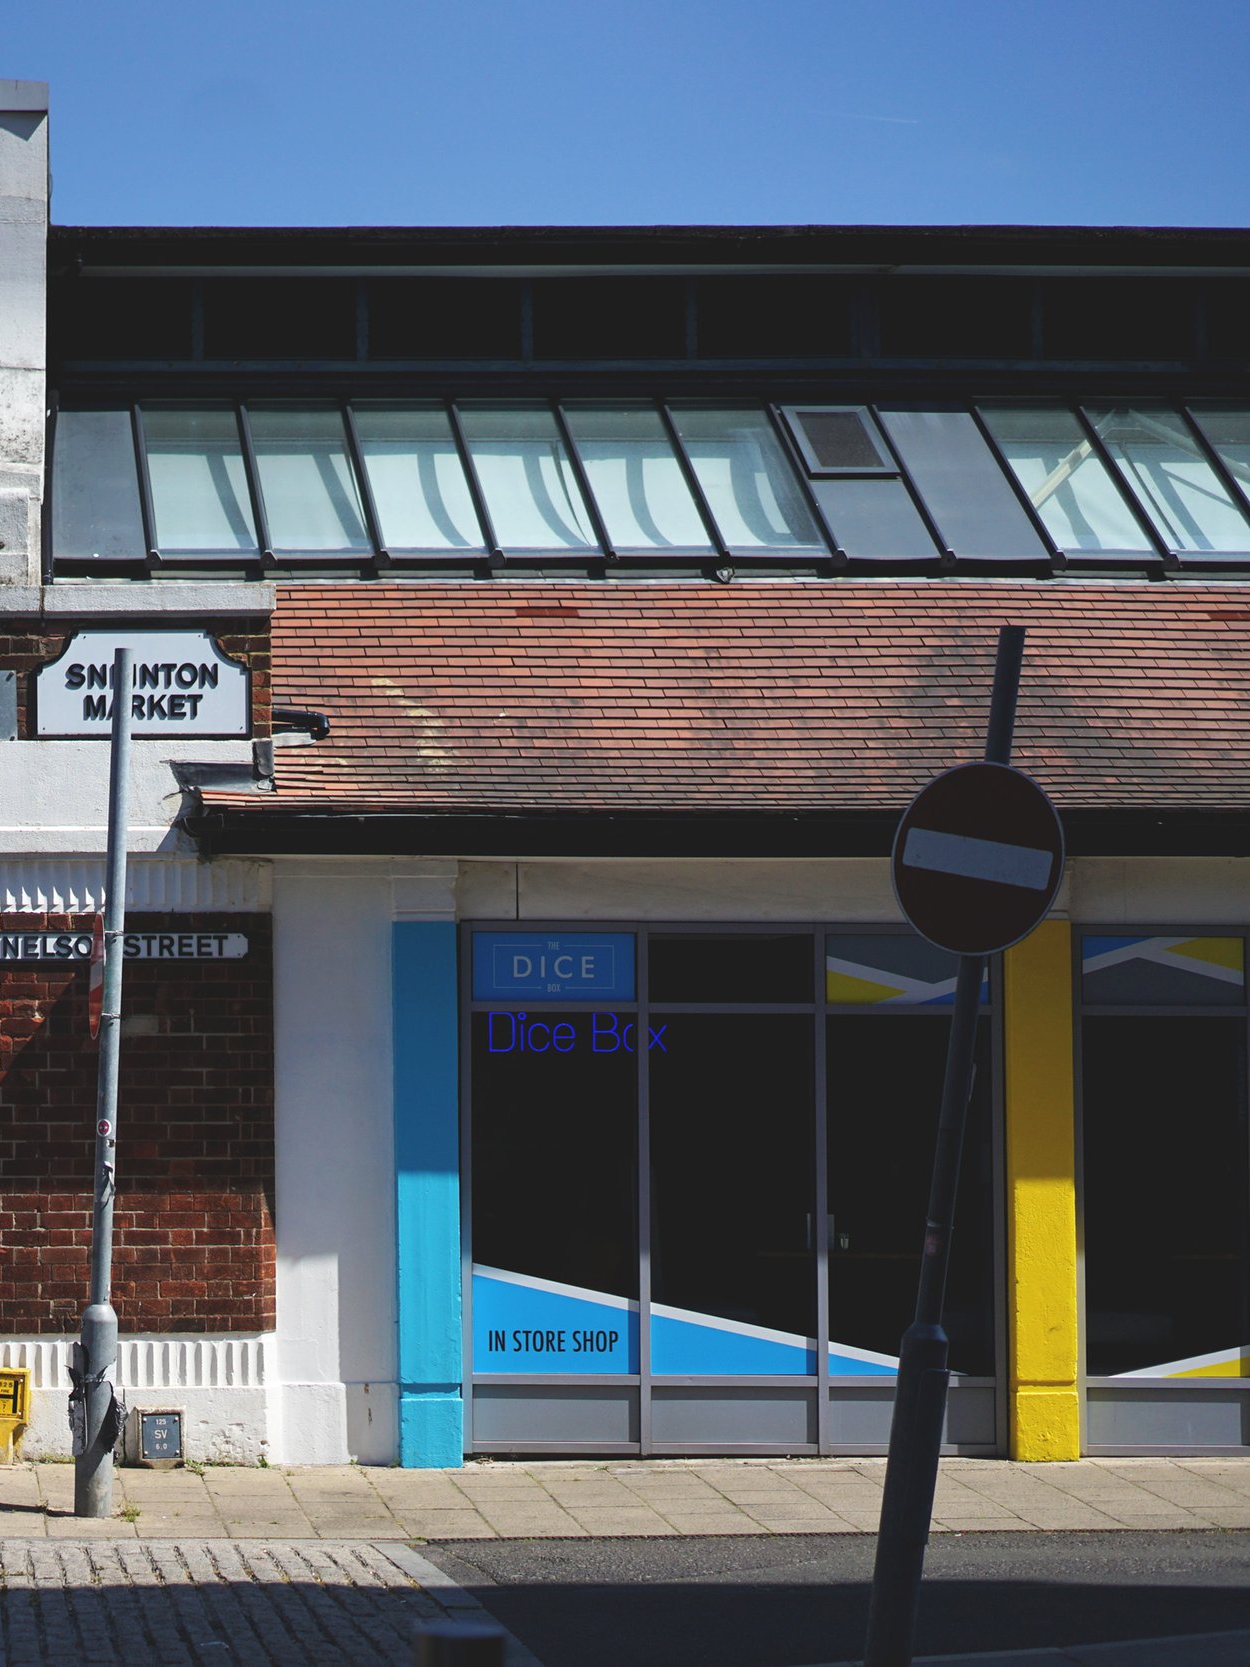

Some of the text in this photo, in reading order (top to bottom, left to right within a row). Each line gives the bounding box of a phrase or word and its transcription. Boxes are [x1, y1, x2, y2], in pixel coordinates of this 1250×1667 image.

[2, 935, 229, 958] NELSO STREET
[548, 941, 560, 950] THE
[513, 956, 595, 979] DICE
[547, 984, 561, 992] BOX
[488, 1011, 576, 1053] Dice
[488, 1330, 619, 1352] IN STORE SHOP
[154, 1429, 168, 1440] SV
